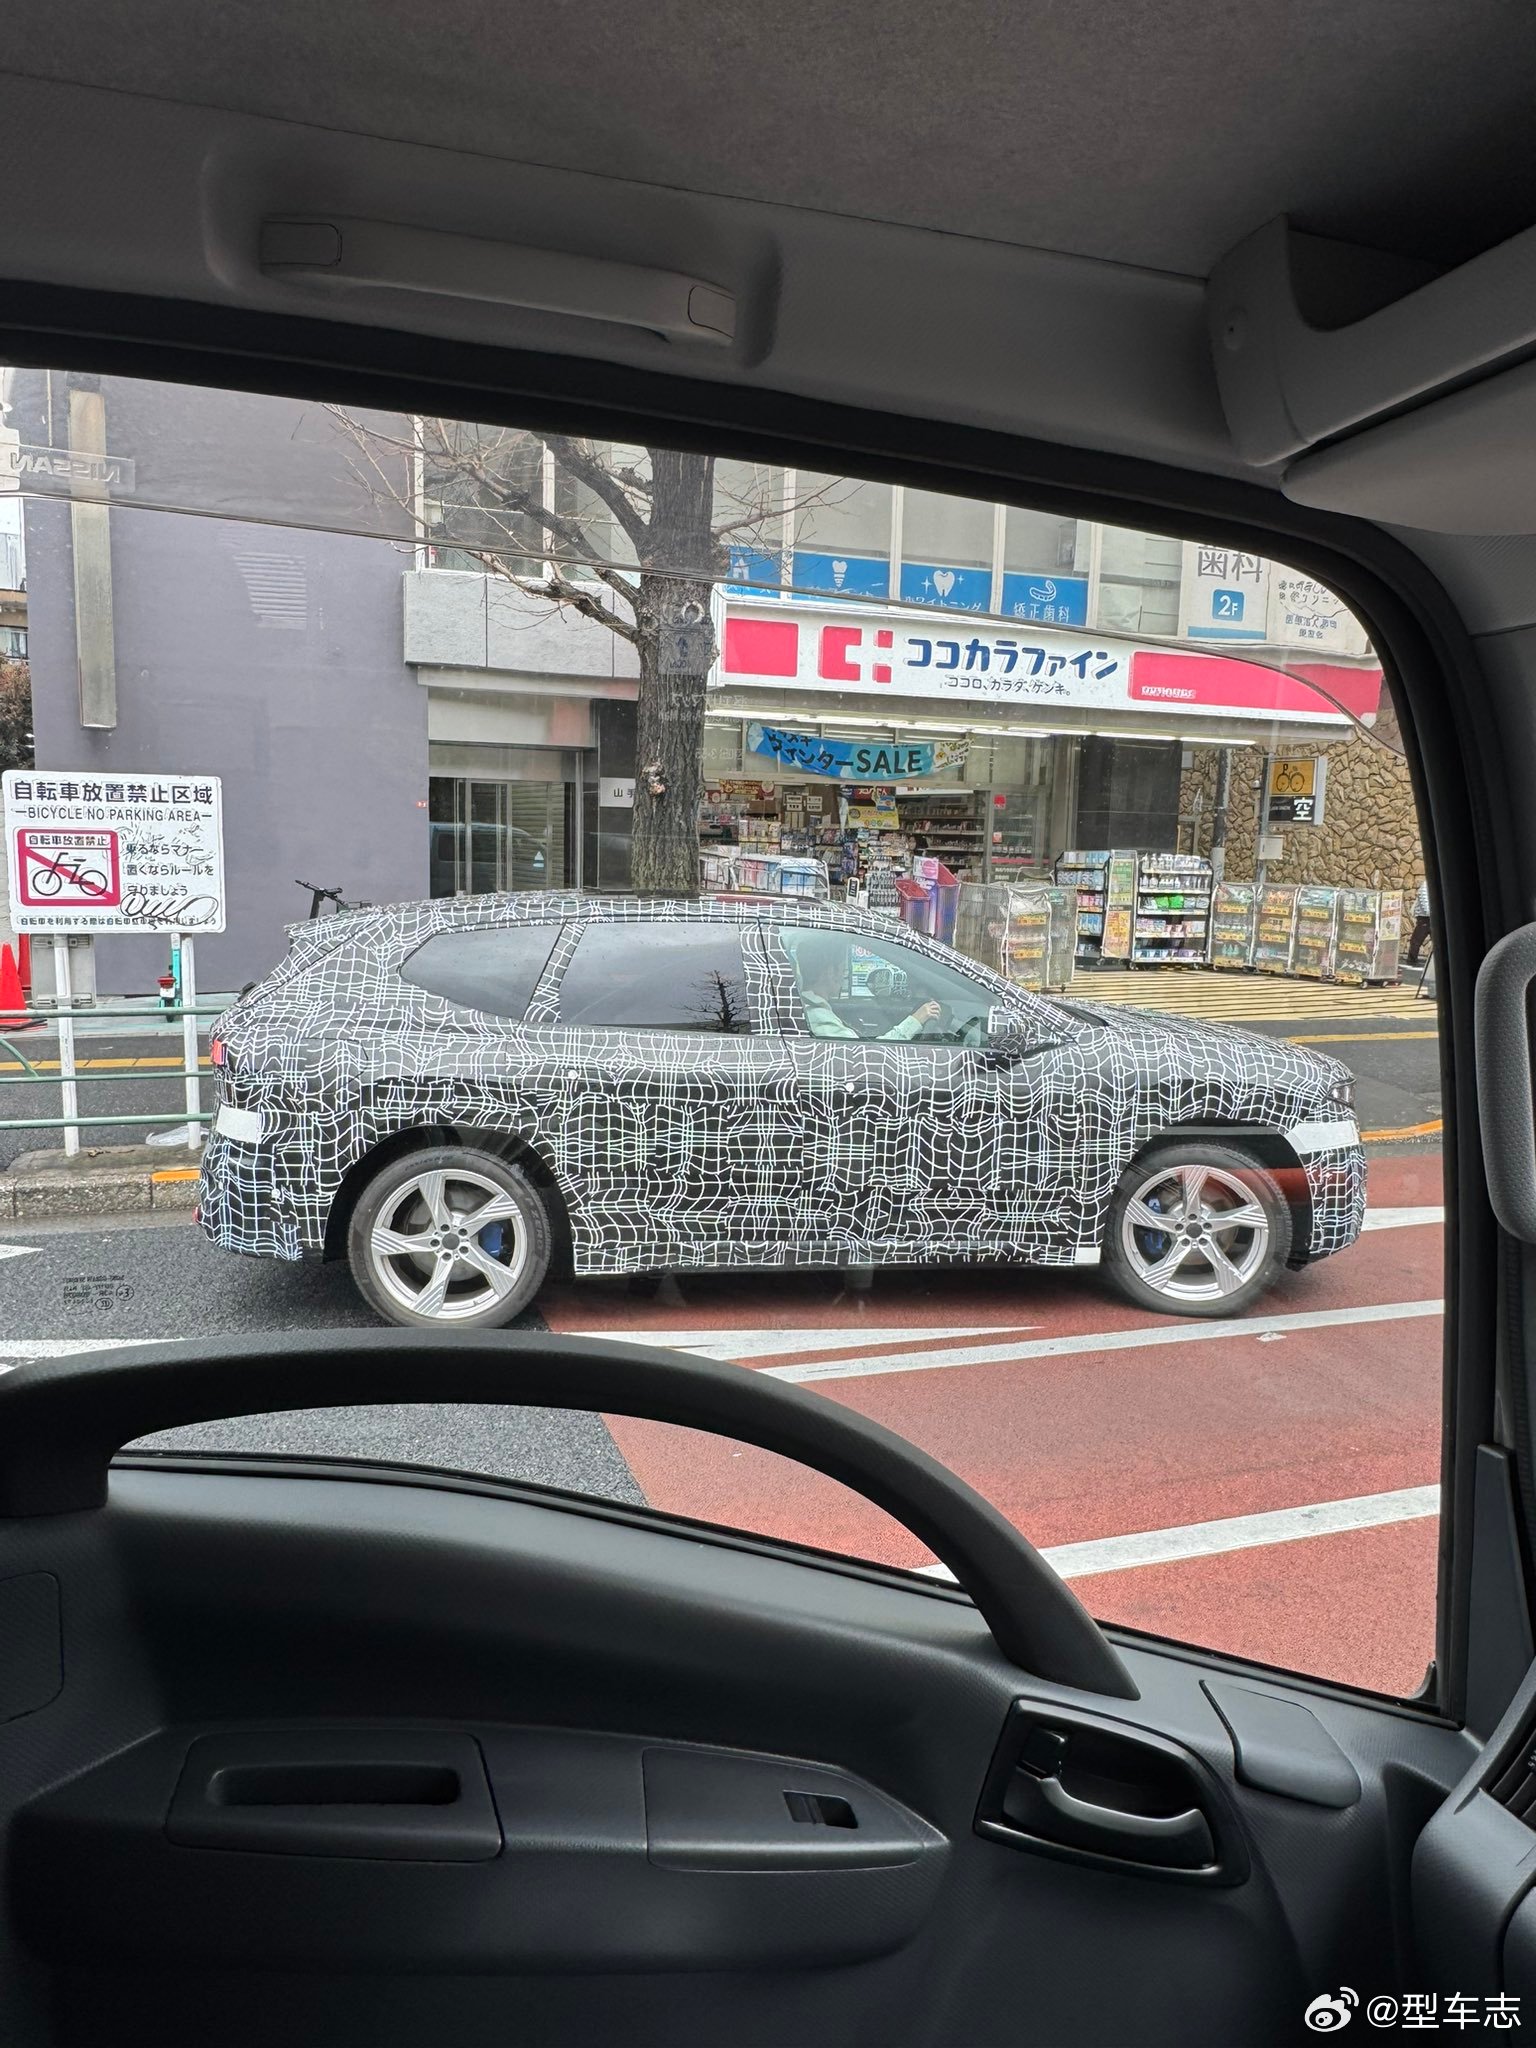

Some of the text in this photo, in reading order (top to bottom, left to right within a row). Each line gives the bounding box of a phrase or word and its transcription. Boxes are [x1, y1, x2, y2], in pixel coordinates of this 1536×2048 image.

[1198, 545, 1263, 583] 歯科
[1217, 595, 1239, 617] 2F
[907, 638, 1118, 681] ココカラファイン
[856, 749, 923, 774] SALE
[14, 781, 213, 805] 自転車放置禁止区域
[28, 807, 201, 822] BICYCLE NO PARKING AREA
[1292, 797, 1313, 821] 空
[29, 834, 108, 847] 自転車放置禁止
[126, 843, 204, 857] 乗るならマナー
[126, 864, 214, 876] 置くならルールを
[127, 885, 188, 896] 守りましょう
